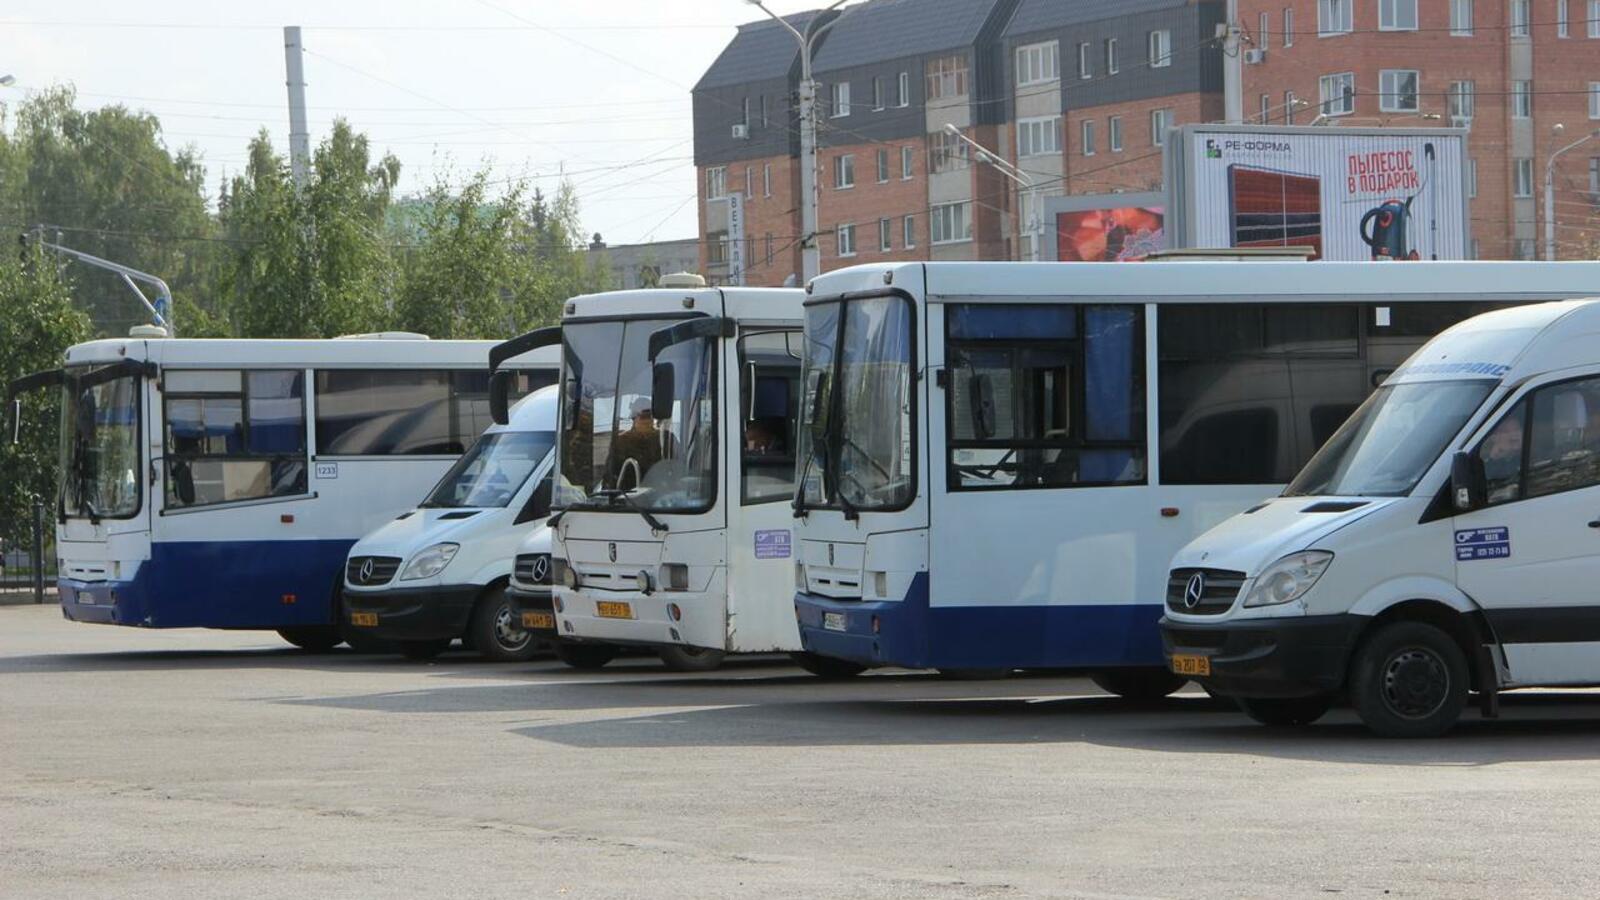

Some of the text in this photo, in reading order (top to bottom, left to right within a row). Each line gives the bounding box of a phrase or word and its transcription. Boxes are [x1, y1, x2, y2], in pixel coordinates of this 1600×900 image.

[1225, 140, 1292, 152] РЕ-ФОРМА
[1348, 150, 1414, 176] ПЫЛЕСОС
[1348, 171, 1419, 194] В ПОДАРОК
[318, 466, 336, 475] 1233
